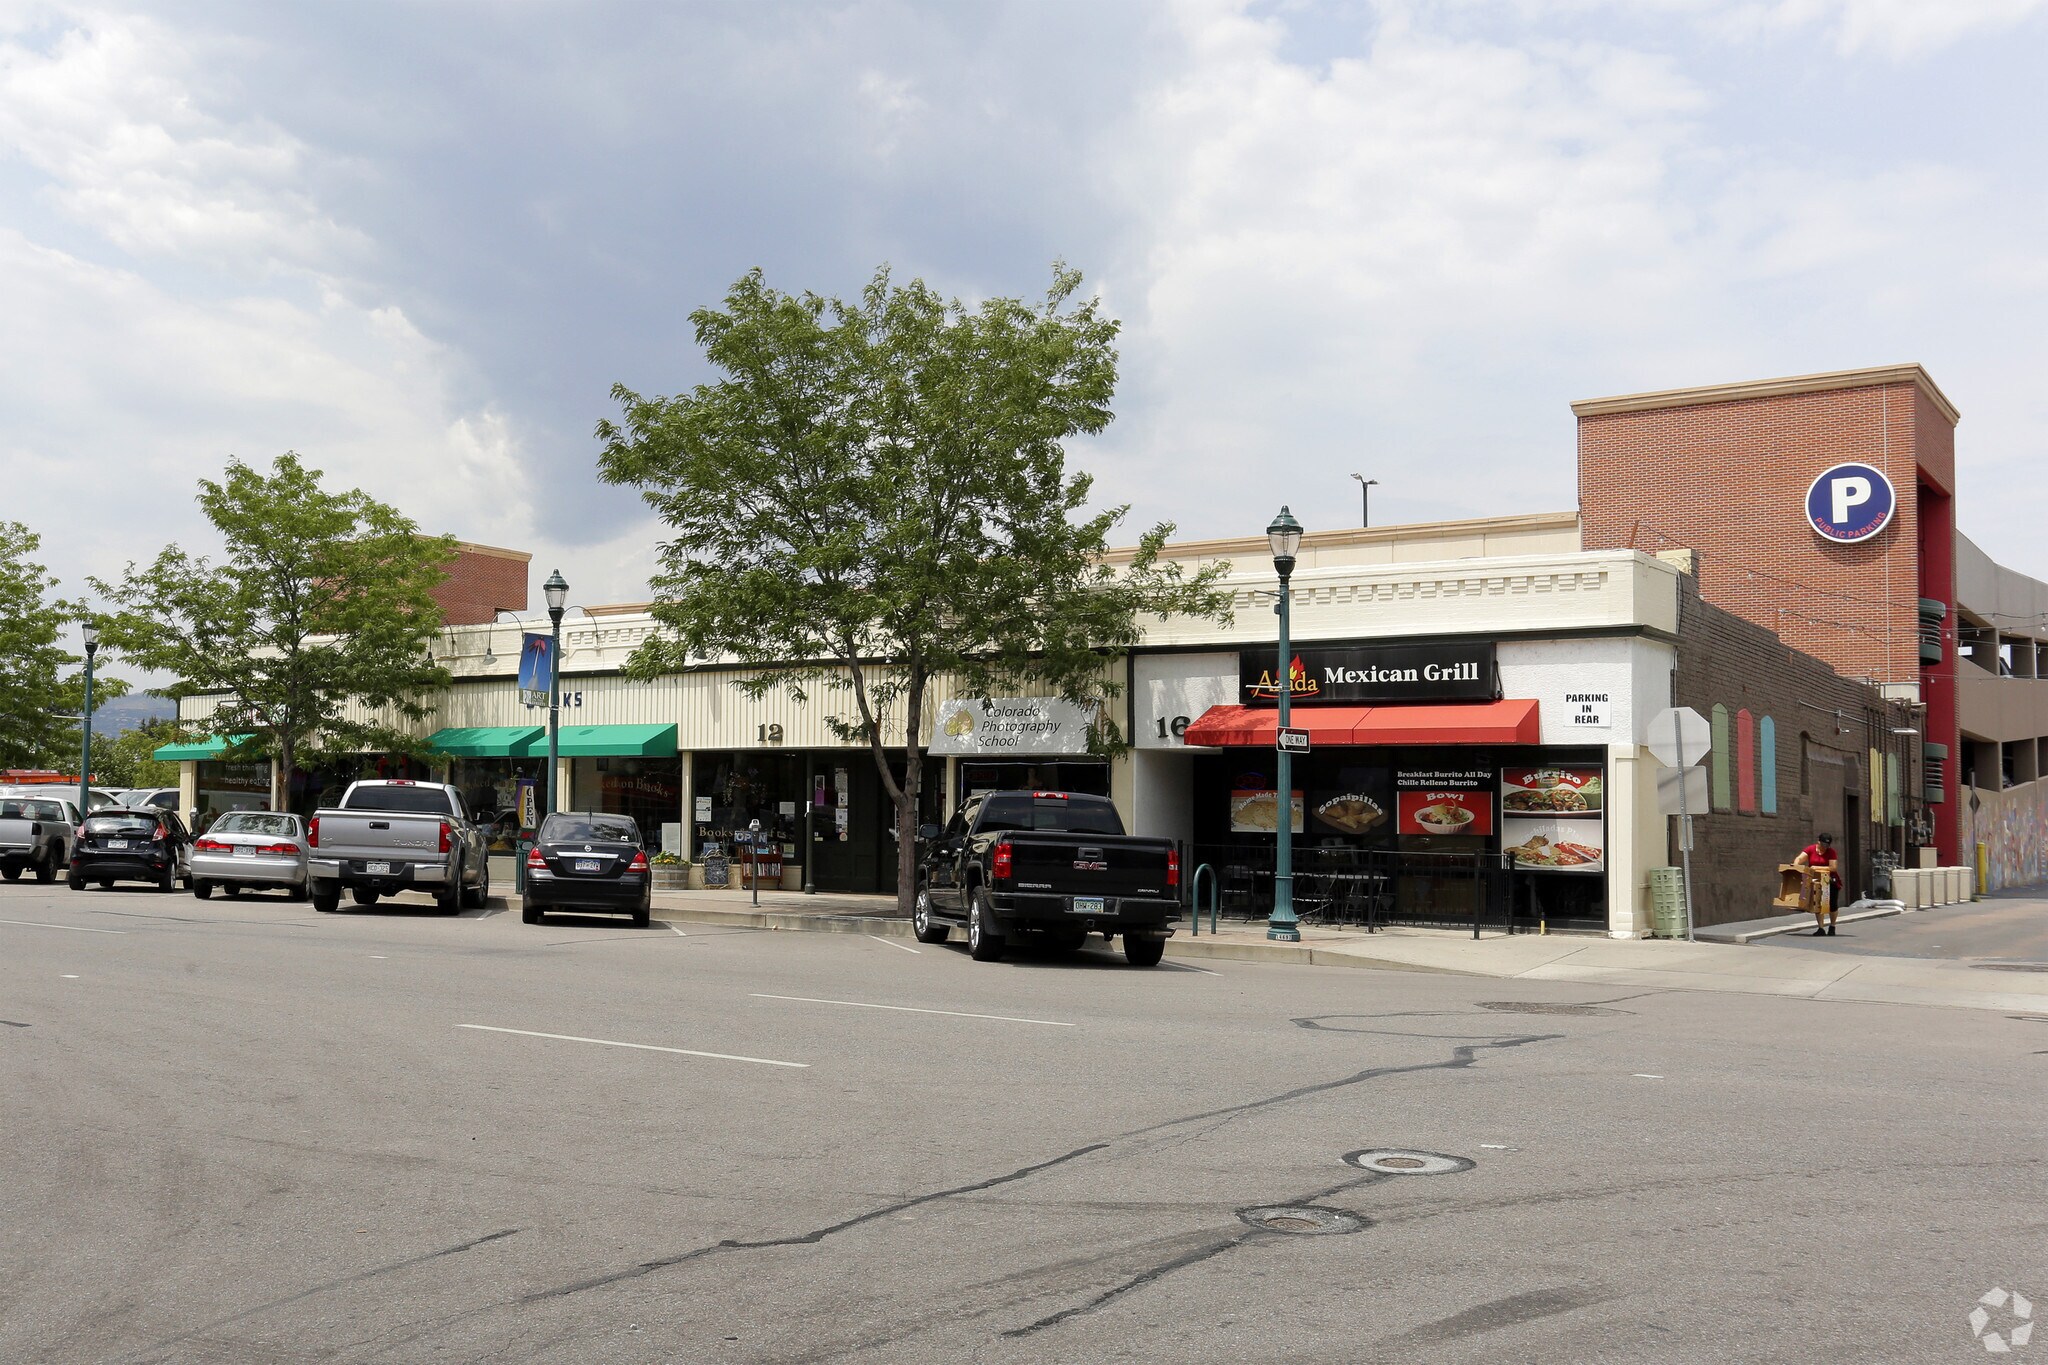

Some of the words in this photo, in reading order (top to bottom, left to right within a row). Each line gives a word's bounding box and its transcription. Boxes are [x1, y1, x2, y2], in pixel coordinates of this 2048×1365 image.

[1831, 476, 1871, 523] P
[1815, 517, 1846, 539] PUBLIC
[1847, 511, 1887, 539] PARKING
[1324, 665, 1419, 684] Mexican
[1423, 662, 1479, 682] Grill
[531, 692, 546, 700] ART
[1565, 693, 1609, 702] PARKING
[985, 705, 1040, 718] Colorado
[1581, 704, 1592, 713] IN
[1574, 715, 1600, 724] REAR
[757, 723, 784, 742] 12
[981, 720, 1062, 735] Photography
[1157, 716, 1191, 738] 16
[977, 735, 1020, 747] School
[1285, 735, 1295, 744] ONE
[1295, 736, 1306, 745] WAY
[1477, 771, 1492, 779] Day
[1522, 769, 1581, 785] Burrito
[225, 776, 249, 787] healthy
[1254, 792, 1273, 800] Made
[1425, 792, 1465, 802] Bowl
[524, 787, 535, 827] OPEN
[1318, 792, 1383, 816] Sopaipillas
[698, 826, 733, 837] Books
[735, 831, 767, 843] OPN
[1073, 861, 1107, 871] GMC
